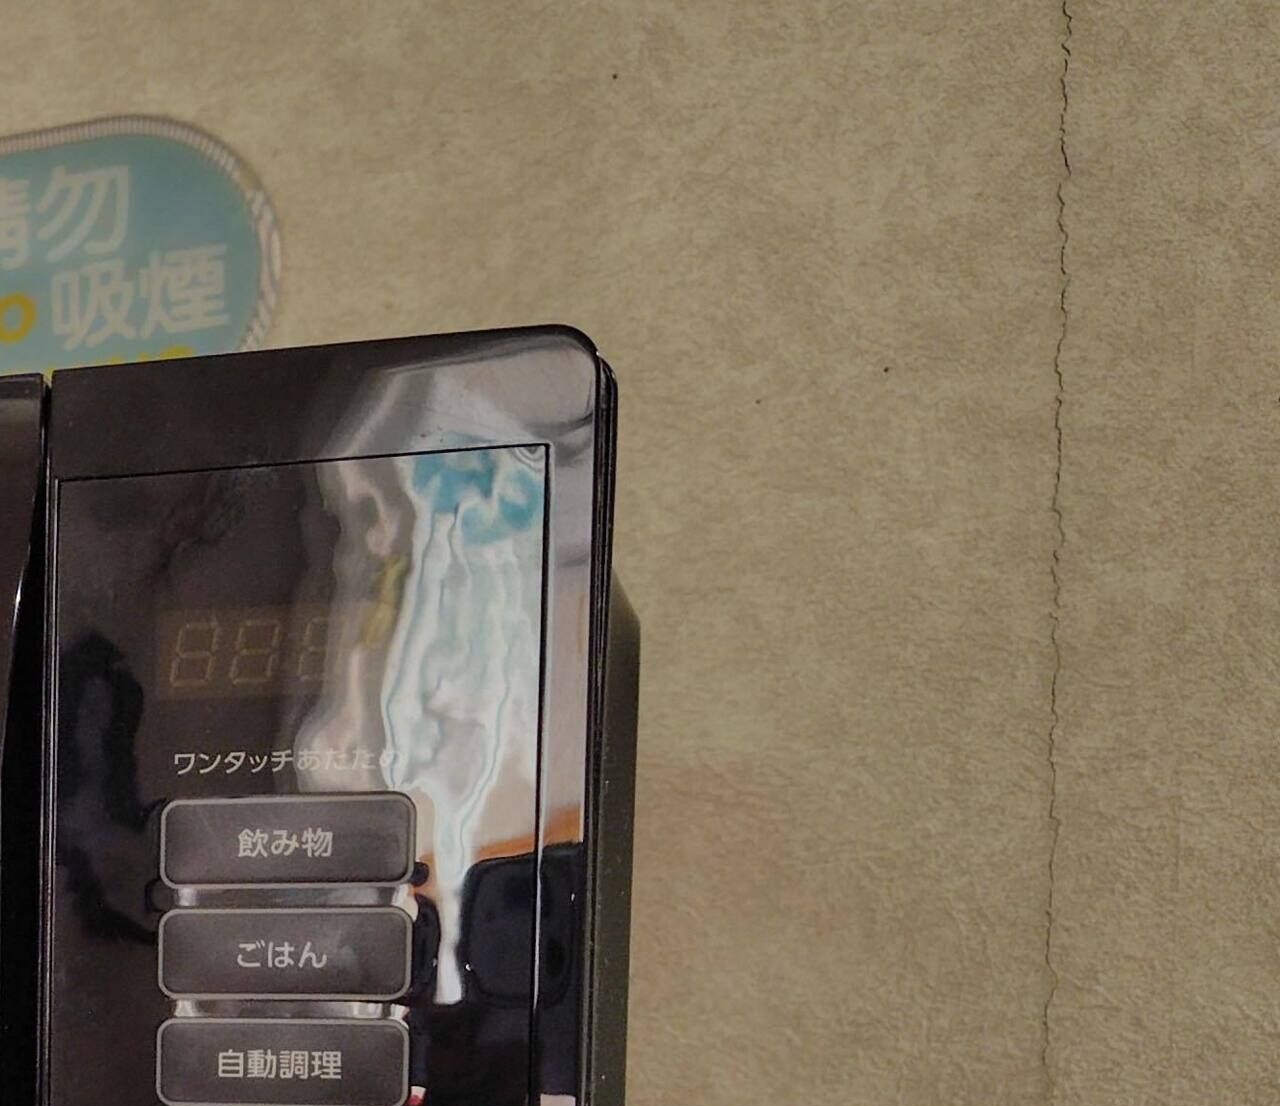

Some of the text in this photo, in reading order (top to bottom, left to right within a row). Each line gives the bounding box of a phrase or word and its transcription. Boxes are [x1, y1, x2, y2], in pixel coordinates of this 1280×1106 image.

[51, 244, 230, 351] 吸煙
[238, 828, 334, 858] 飲み物
[236, 939, 328, 969] ごはん
[217, 1049, 343, 1080] 自動調理
